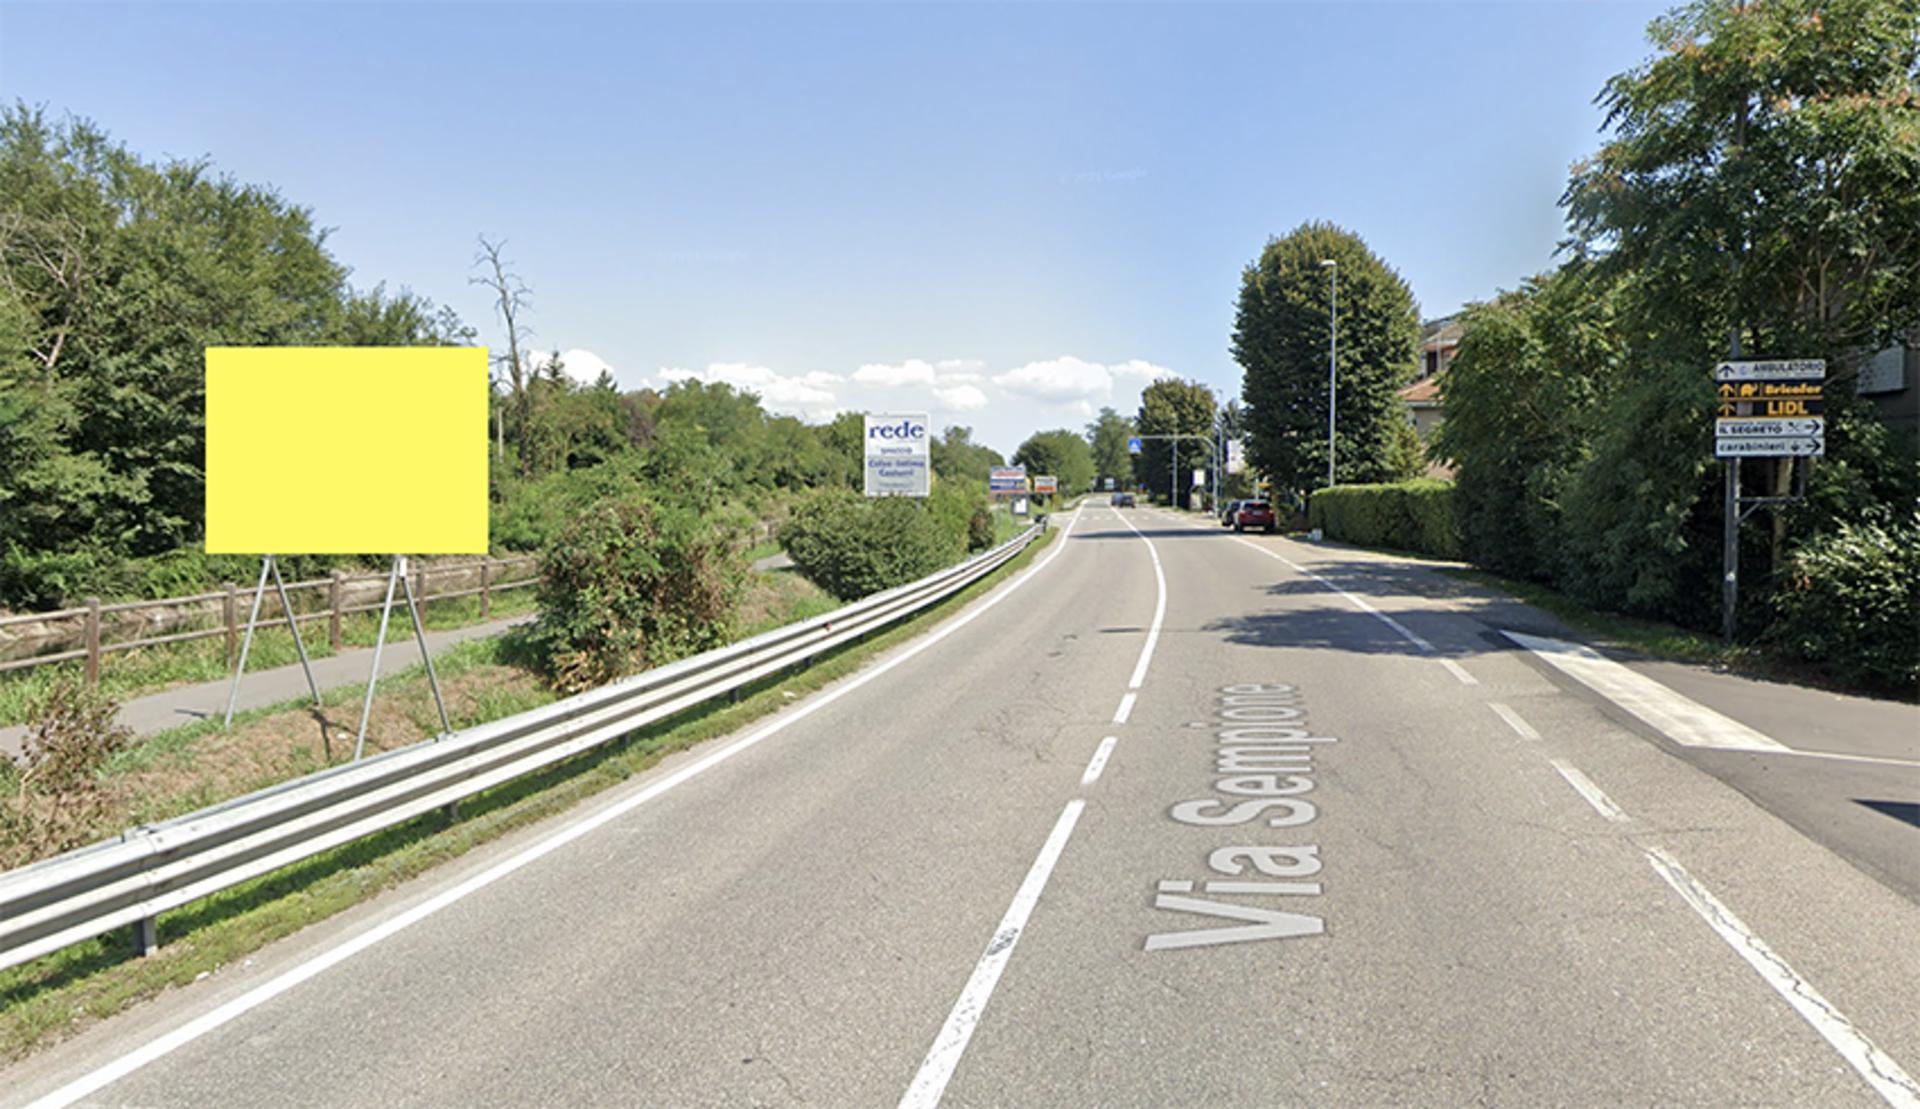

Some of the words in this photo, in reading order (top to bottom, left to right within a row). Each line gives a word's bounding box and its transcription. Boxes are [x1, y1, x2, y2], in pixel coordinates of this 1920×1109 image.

[1754, 362, 1824, 371] AMBULATORIO
[1767, 401, 1808, 415] LIDL
[869, 421, 924, 438] rede
[1731, 425, 1783, 434] SEGRETO
[1719, 442, 1785, 452] carabinieri
